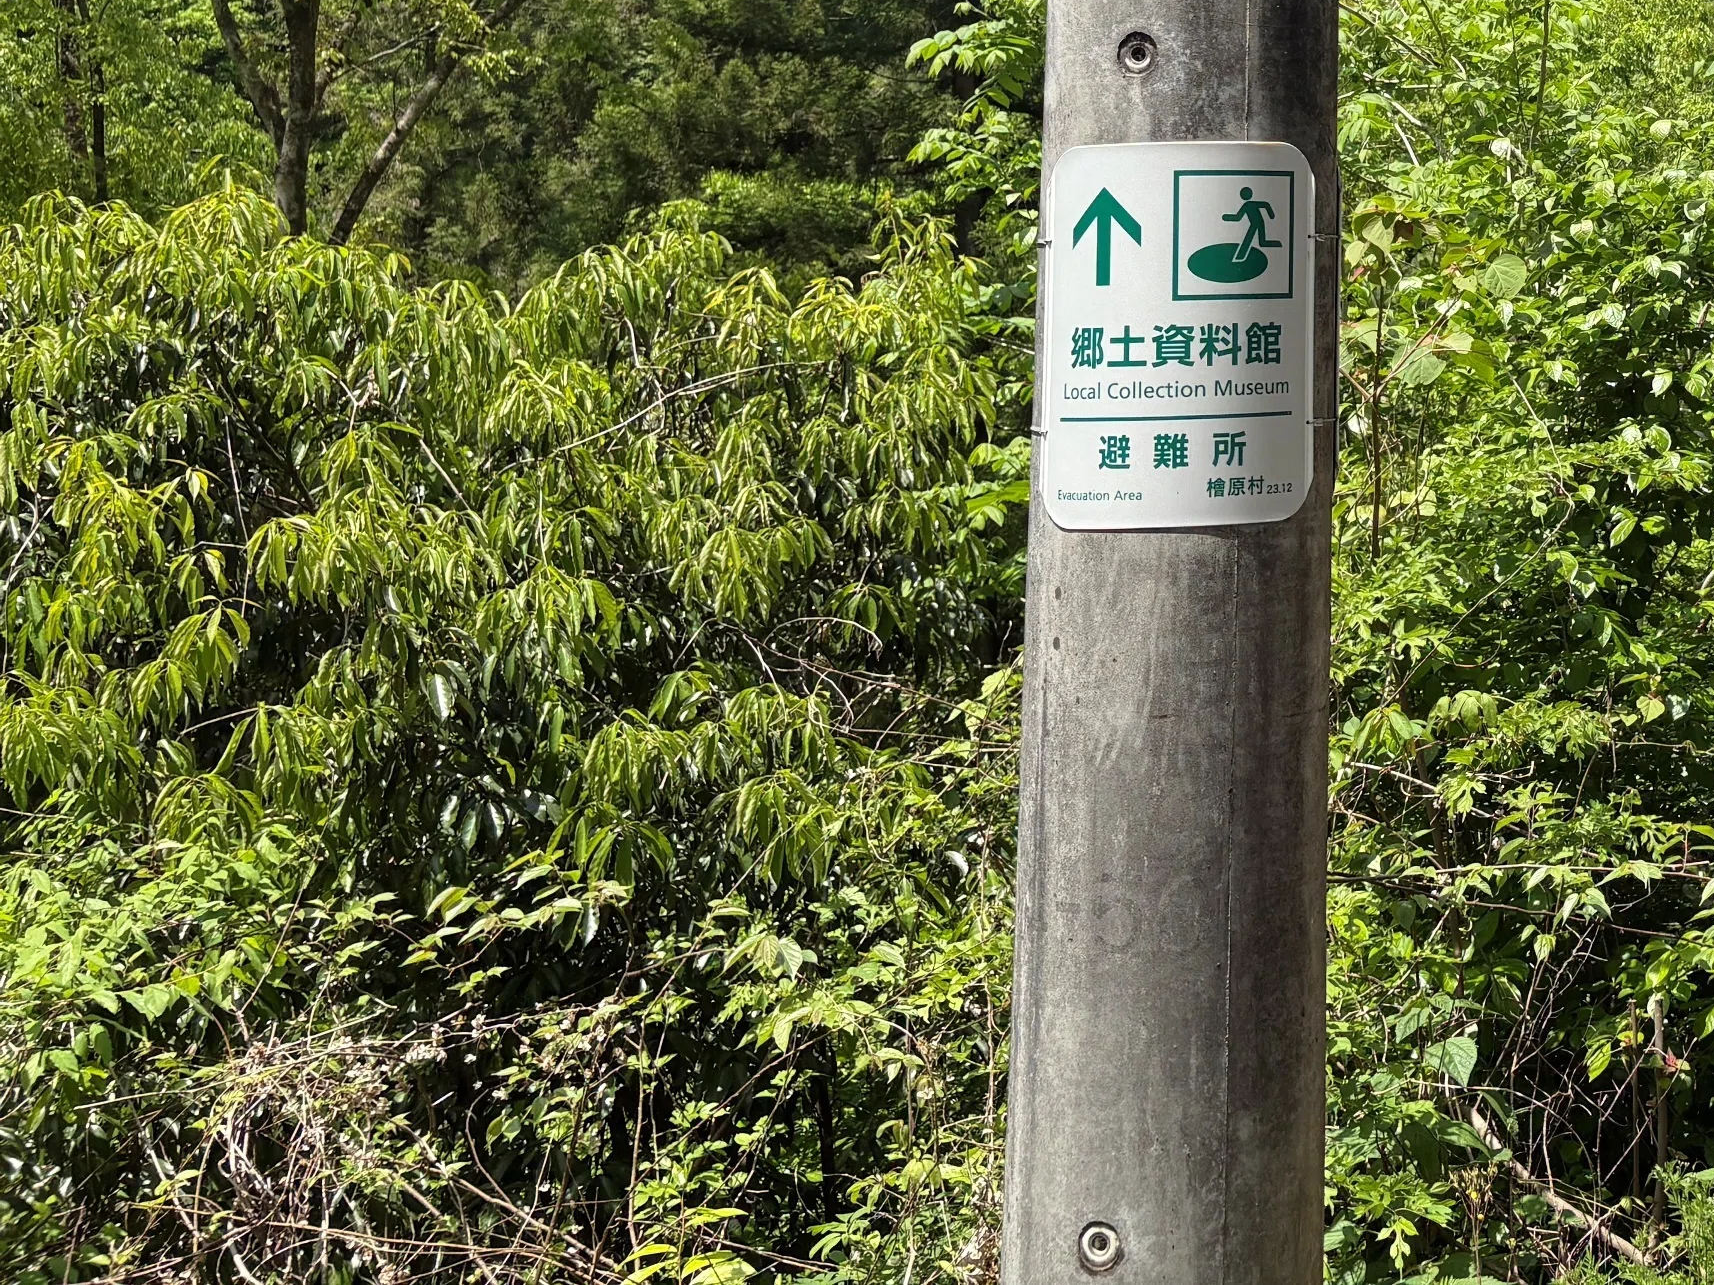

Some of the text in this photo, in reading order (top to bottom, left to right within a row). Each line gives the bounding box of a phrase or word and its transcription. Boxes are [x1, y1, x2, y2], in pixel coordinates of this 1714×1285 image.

[1071, 321, 1282, 369] 郷土資料館
[1063, 379, 1289, 400] Local Collection Museum
[1098, 430, 1247, 470] 避難所
[1057, 489, 1143, 501] Evacuation Area
[1206, 475, 1293, 498] 檜原村 23.12
